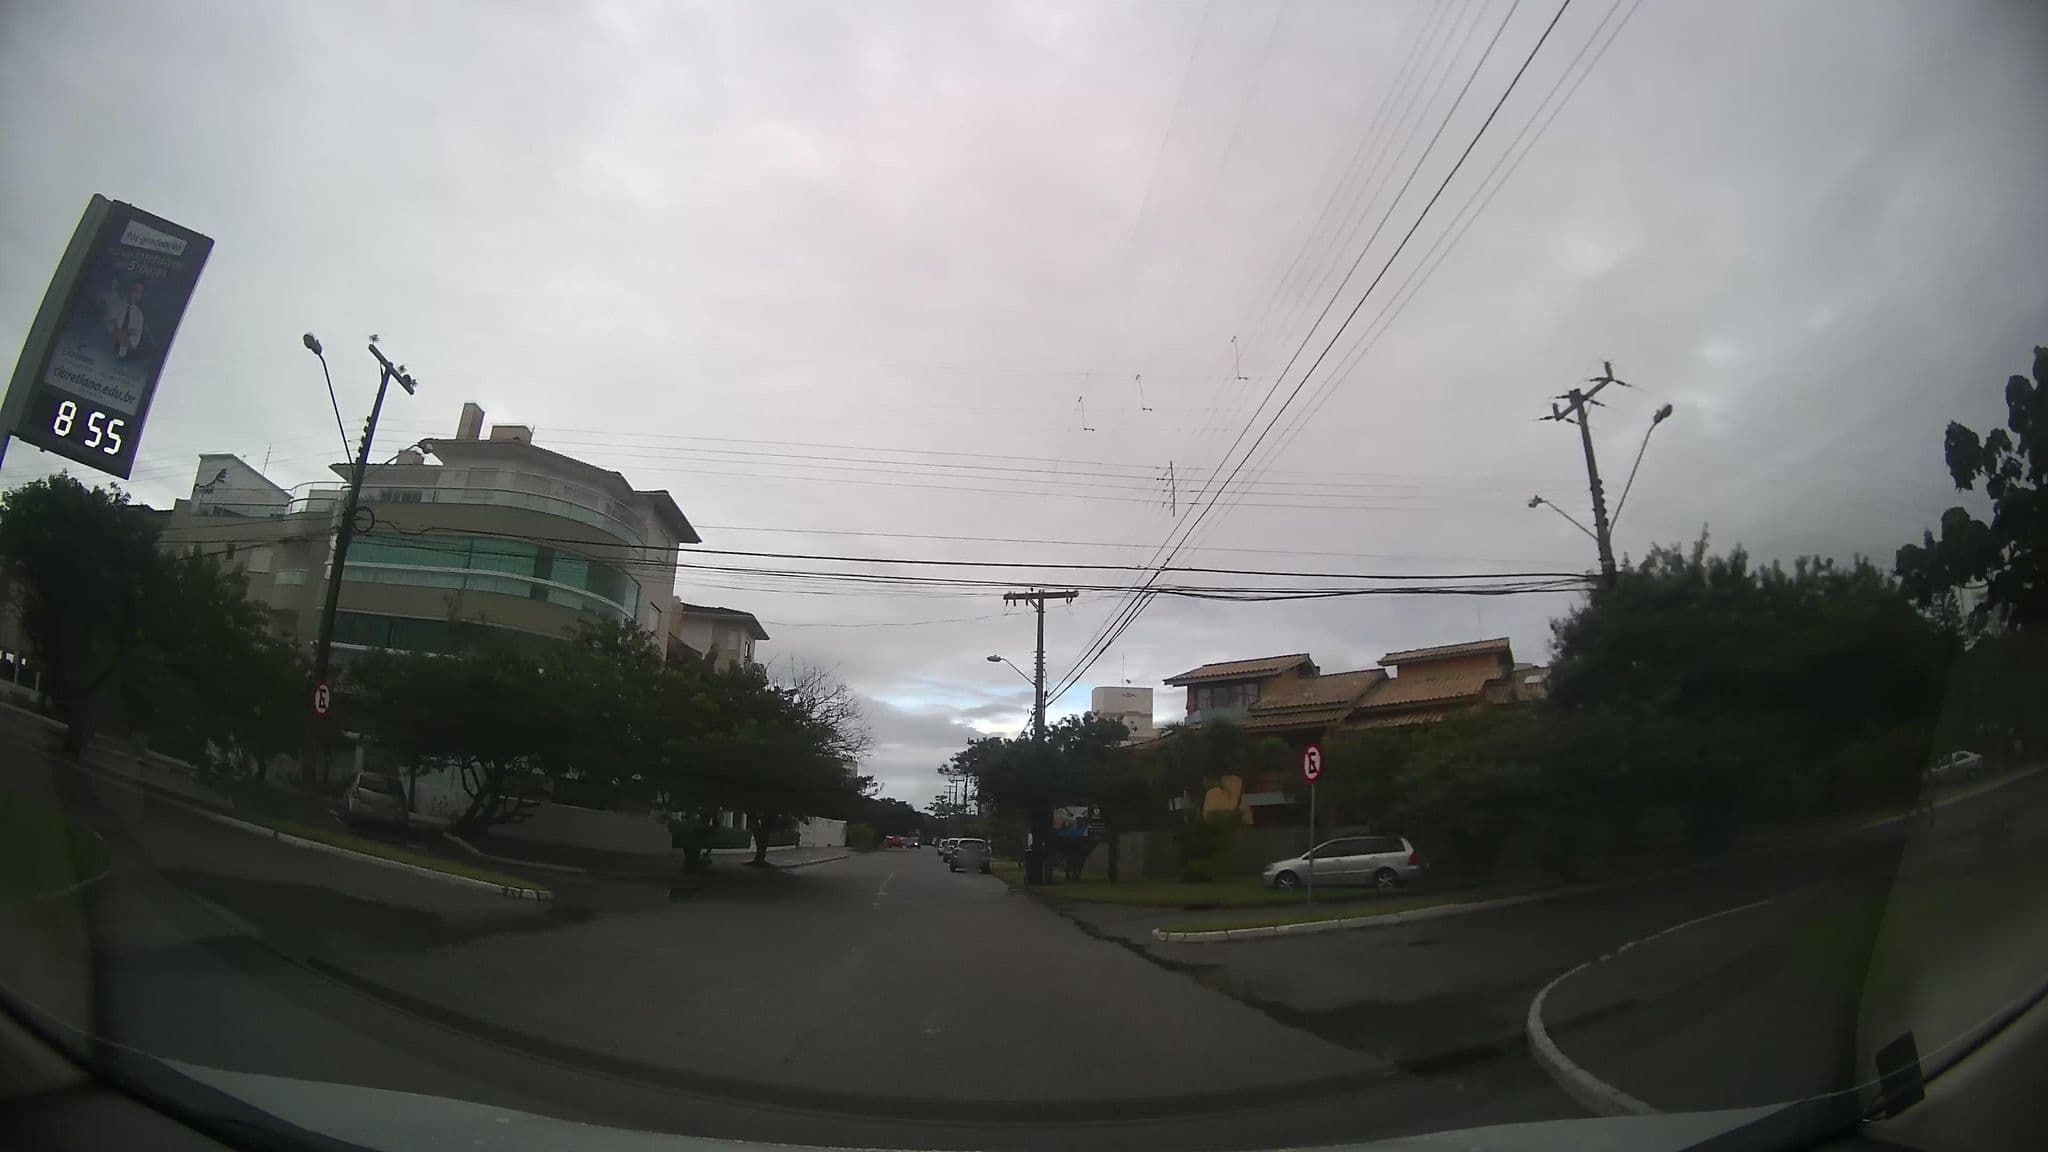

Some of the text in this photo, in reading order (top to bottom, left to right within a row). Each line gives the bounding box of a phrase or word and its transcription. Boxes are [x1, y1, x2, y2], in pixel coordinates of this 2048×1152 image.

[54, 366, 136, 405] claretiano.edu.br
[53, 400, 125, 455] 8 55
